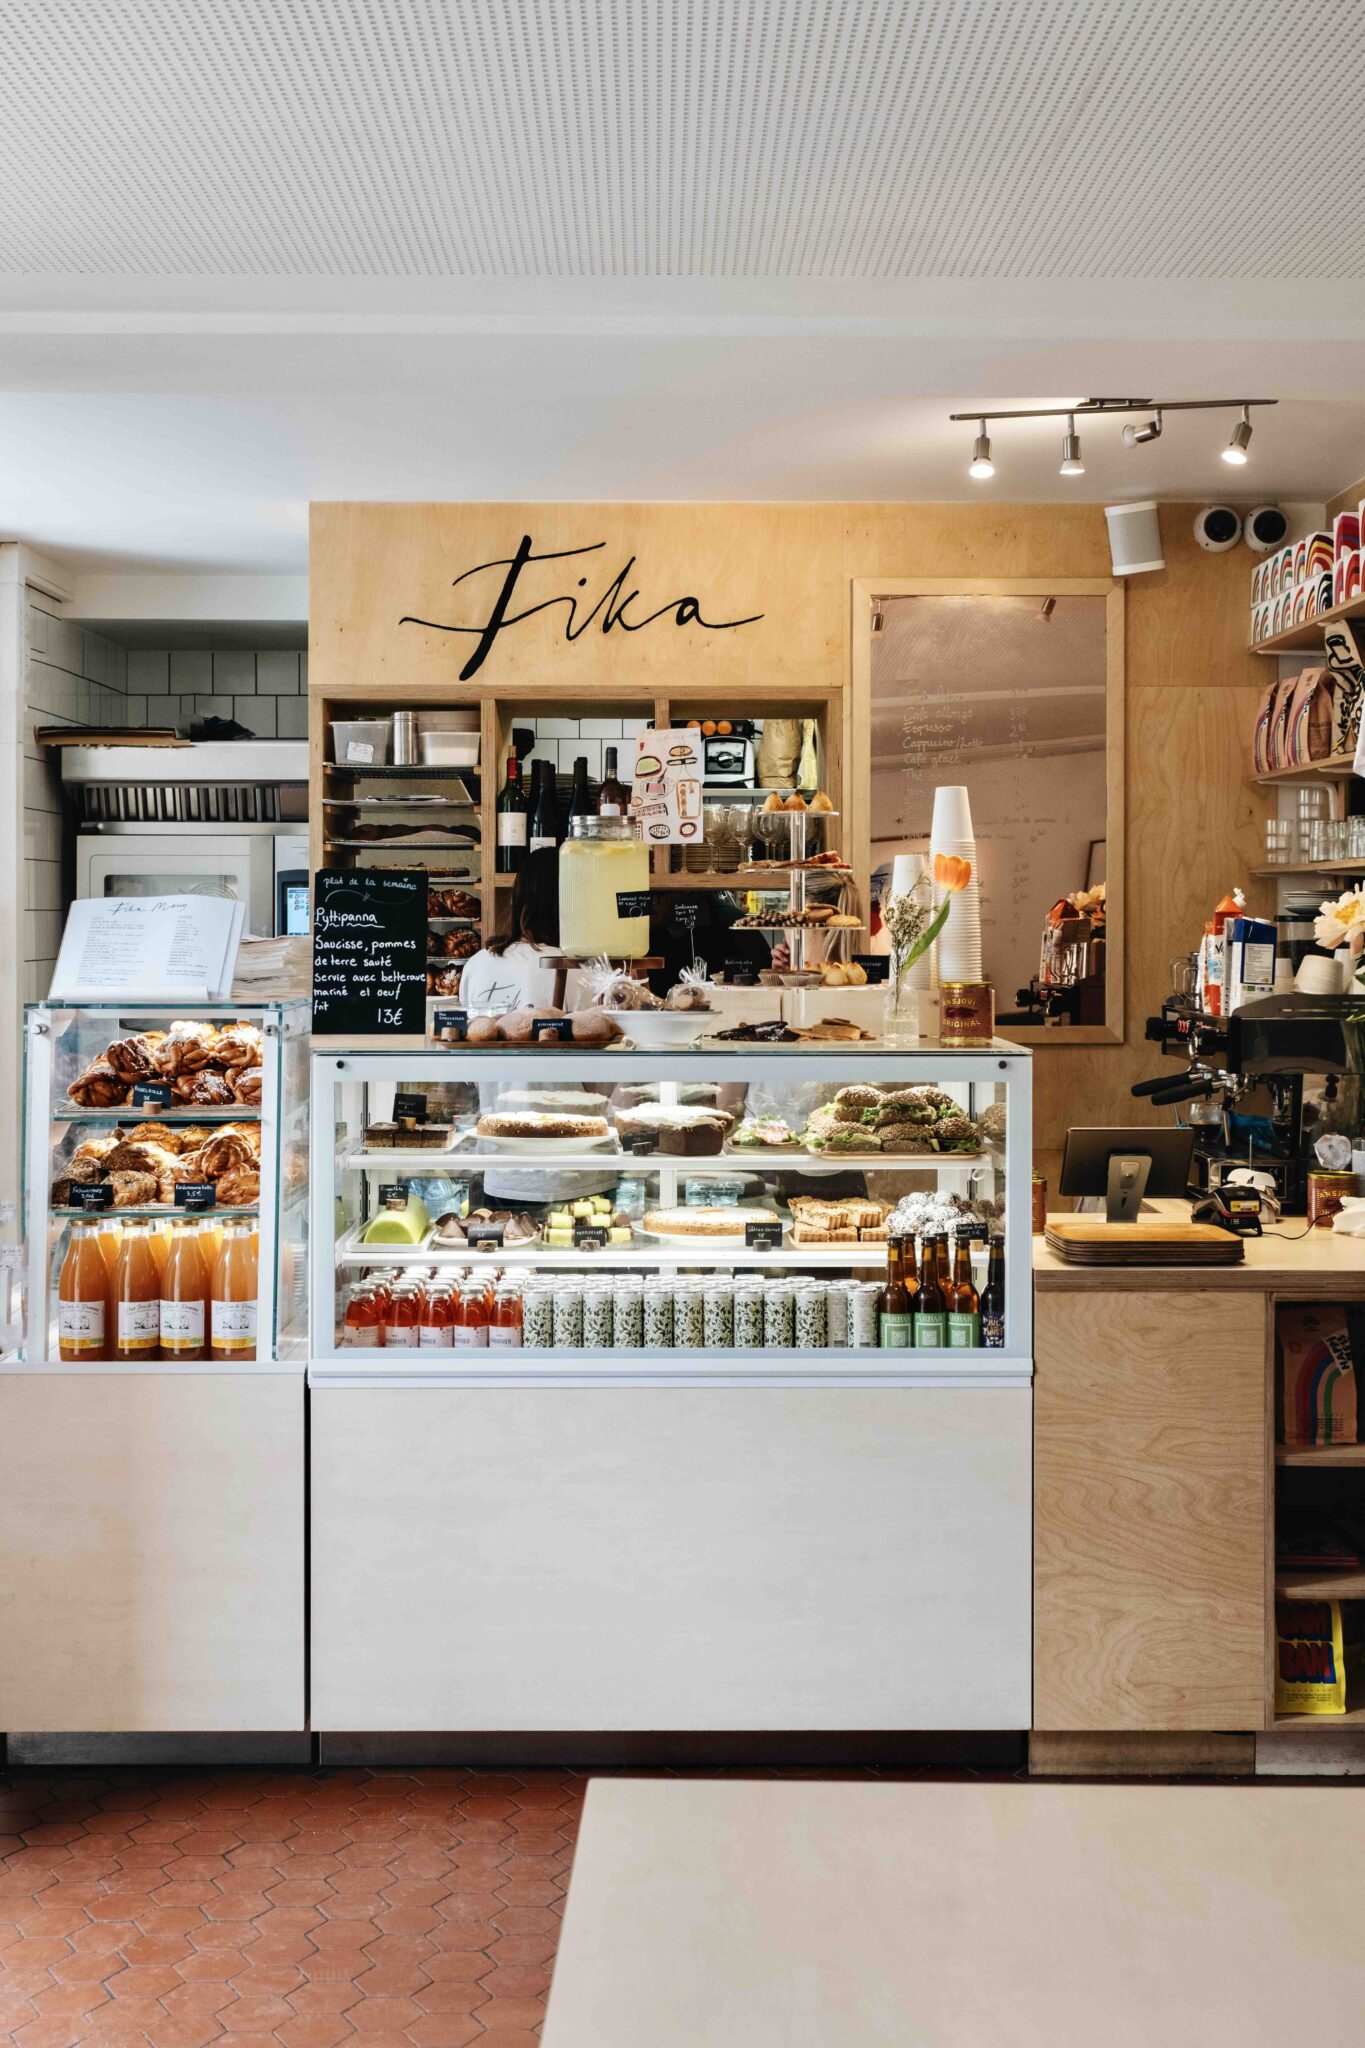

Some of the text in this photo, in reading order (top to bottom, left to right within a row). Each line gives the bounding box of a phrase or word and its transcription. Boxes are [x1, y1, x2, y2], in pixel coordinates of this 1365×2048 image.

[399, 535, 764, 681] Fika
[902, 721, 955, 736] Espresso
[323, 876, 344, 888] plat
[349, 877, 359, 885] de
[365, 877, 376, 886] la
[315, 907, 378, 931] Pyttipanna
[315, 935, 416, 955] Saucisse, pommes
[315, 956, 392, 967] de terre sauté
[314, 971, 426, 982] servie avec betterave
[314, 983, 402, 1000] mariné et oeuf
[378, 1008, 403, 1025] 13€
[1279, 1642, 1336, 1684] BAM
